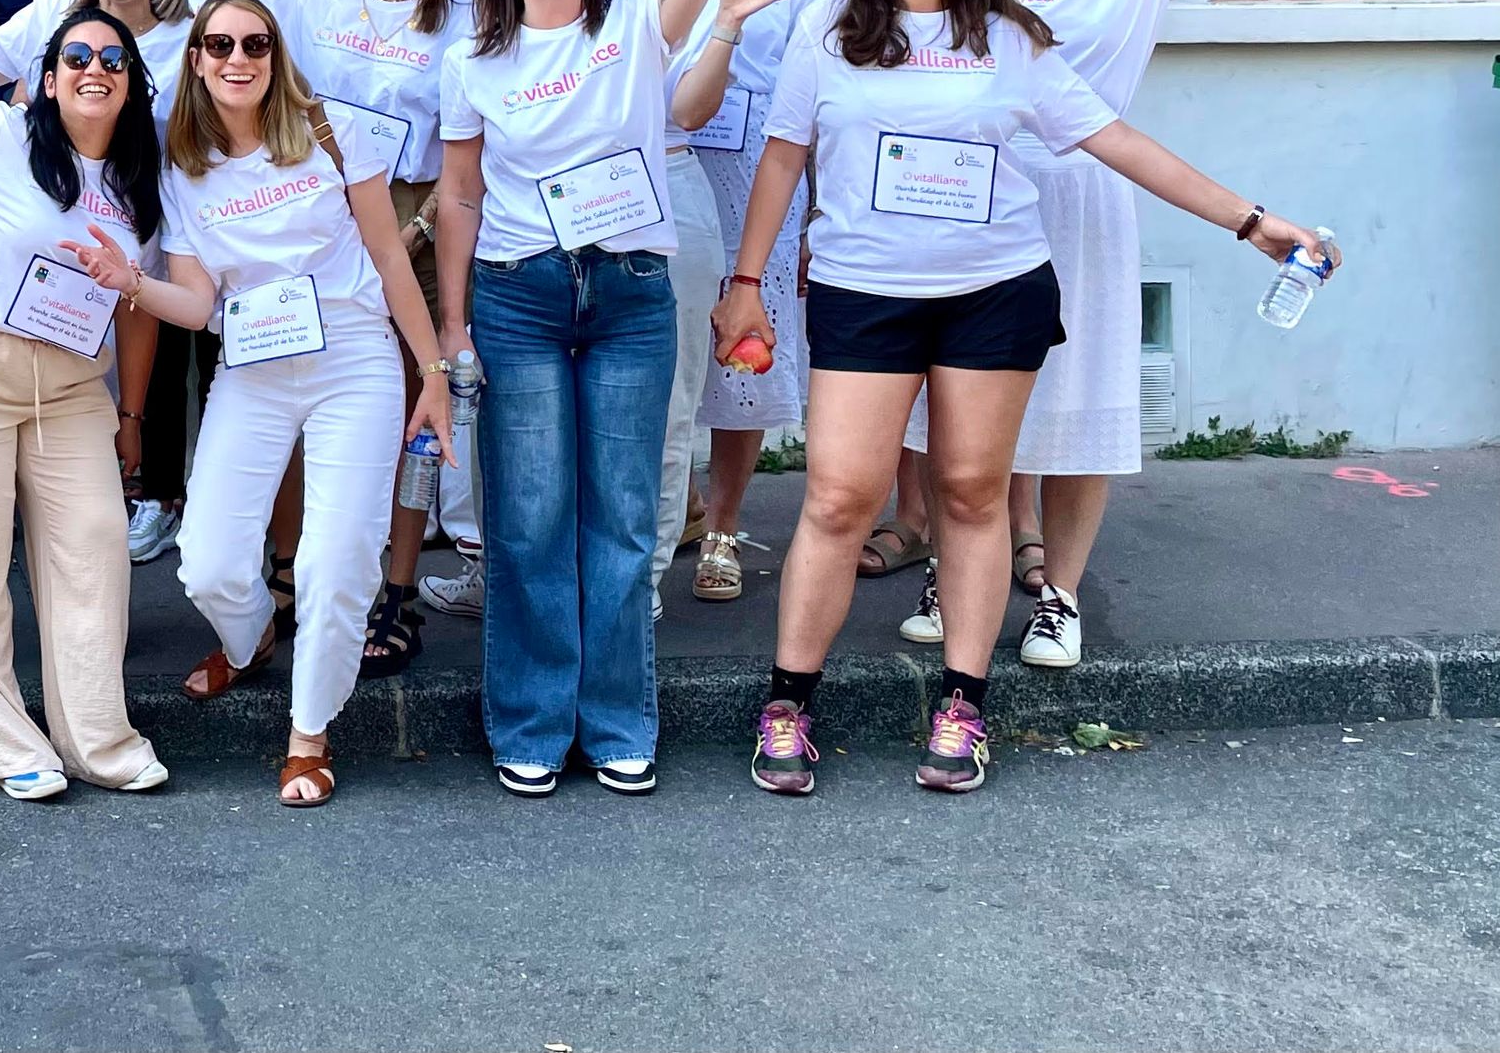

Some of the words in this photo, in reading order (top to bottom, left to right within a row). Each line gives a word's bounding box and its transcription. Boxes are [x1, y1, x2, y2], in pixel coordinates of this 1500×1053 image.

[913, 173, 968, 186] vitalliance
[218, 175, 321, 217] vitalliance
[581, 189, 631, 211] vitalliance
